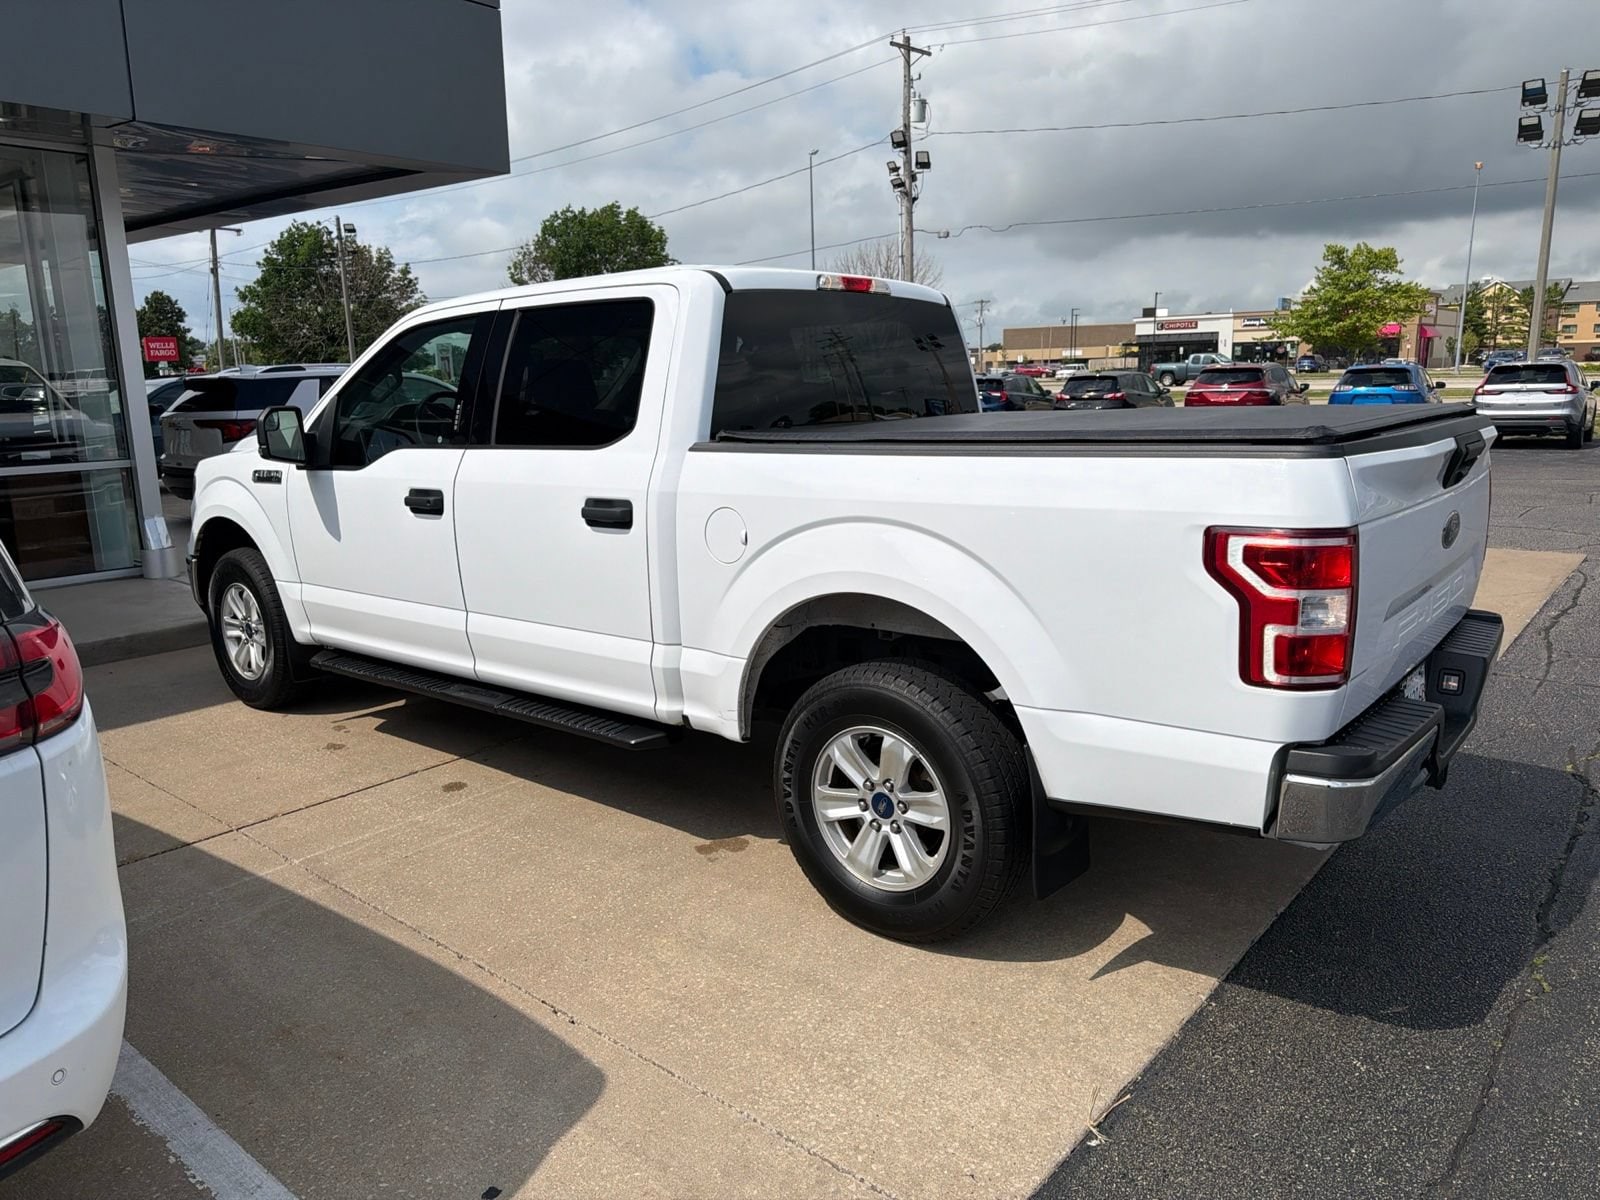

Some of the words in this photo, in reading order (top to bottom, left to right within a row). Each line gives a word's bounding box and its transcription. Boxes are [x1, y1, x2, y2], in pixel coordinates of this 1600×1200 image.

[1164, 321, 1197, 329] CHIPOTLE
[150, 349, 176, 357] FARGO
[952, 792, 976, 892] ADVANTA
